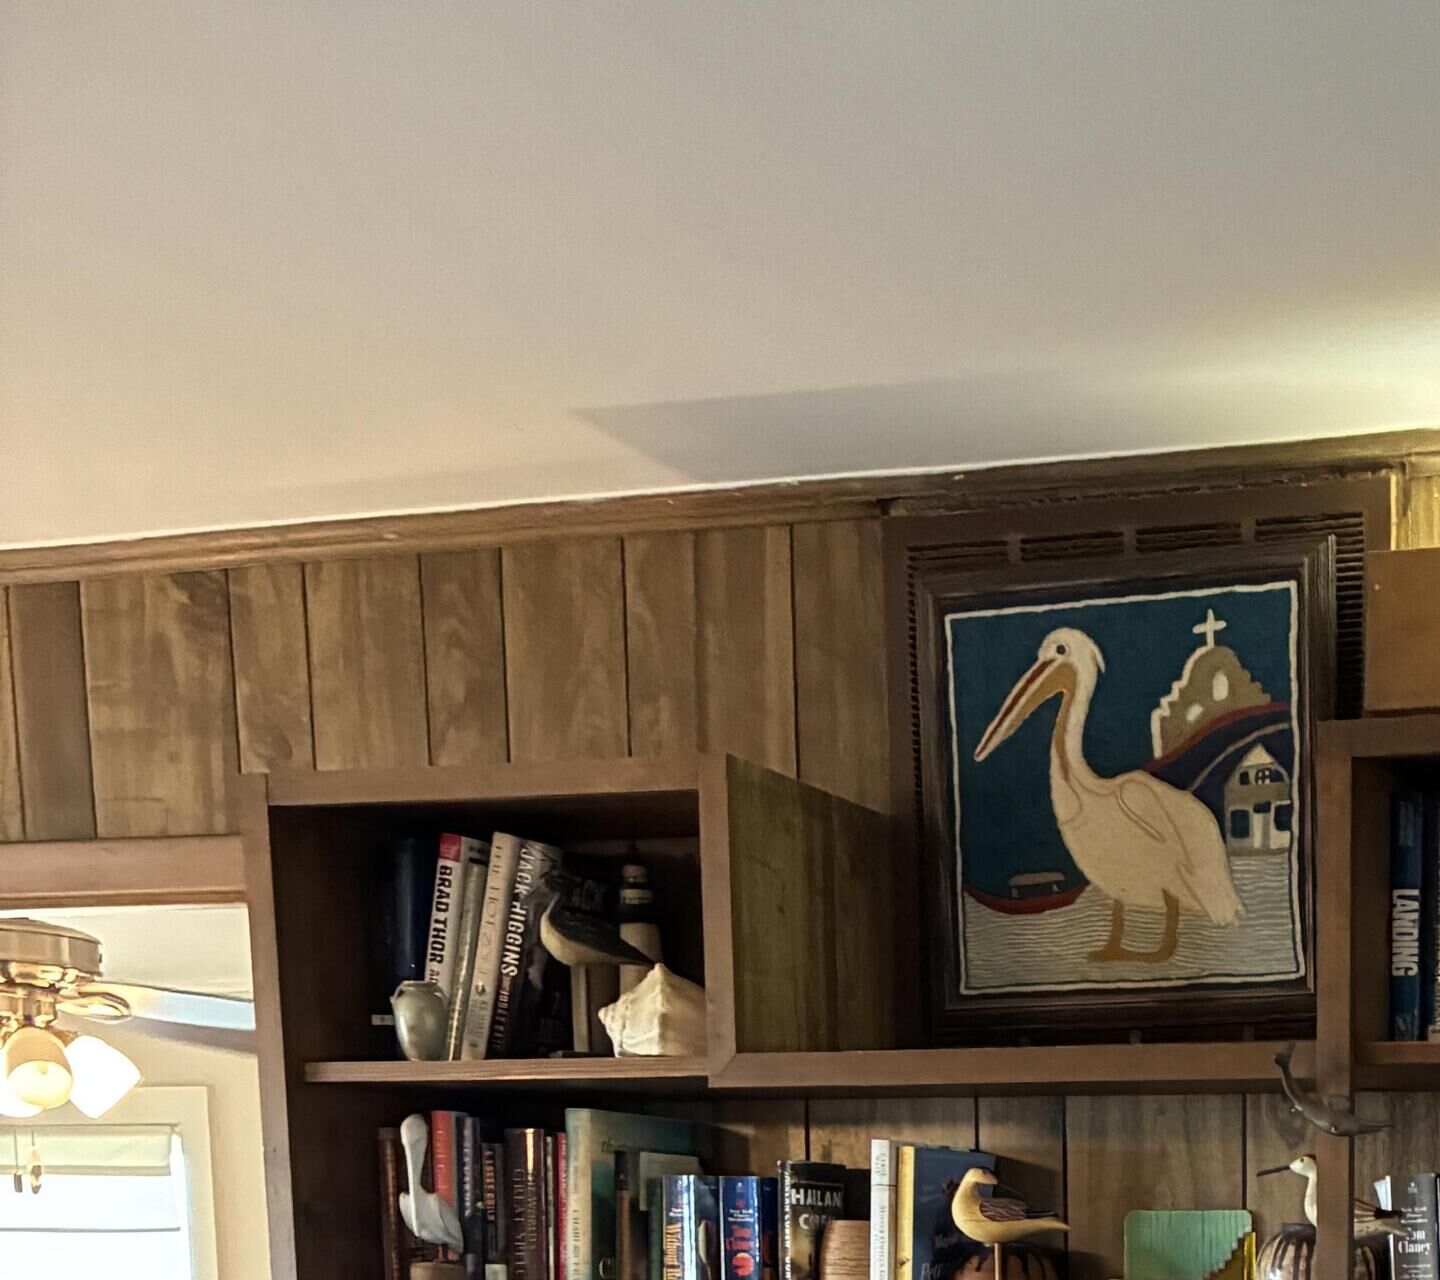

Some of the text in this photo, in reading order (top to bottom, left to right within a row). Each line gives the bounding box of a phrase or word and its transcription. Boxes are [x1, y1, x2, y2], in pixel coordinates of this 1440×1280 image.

[429, 864, 452, 963] BRAD THOR
[501, 848, 535, 976] JACK HIGGINS
[1392, 889, 1419, 976] LANDING
[1398, 1241, 1432, 1255] Clancy
